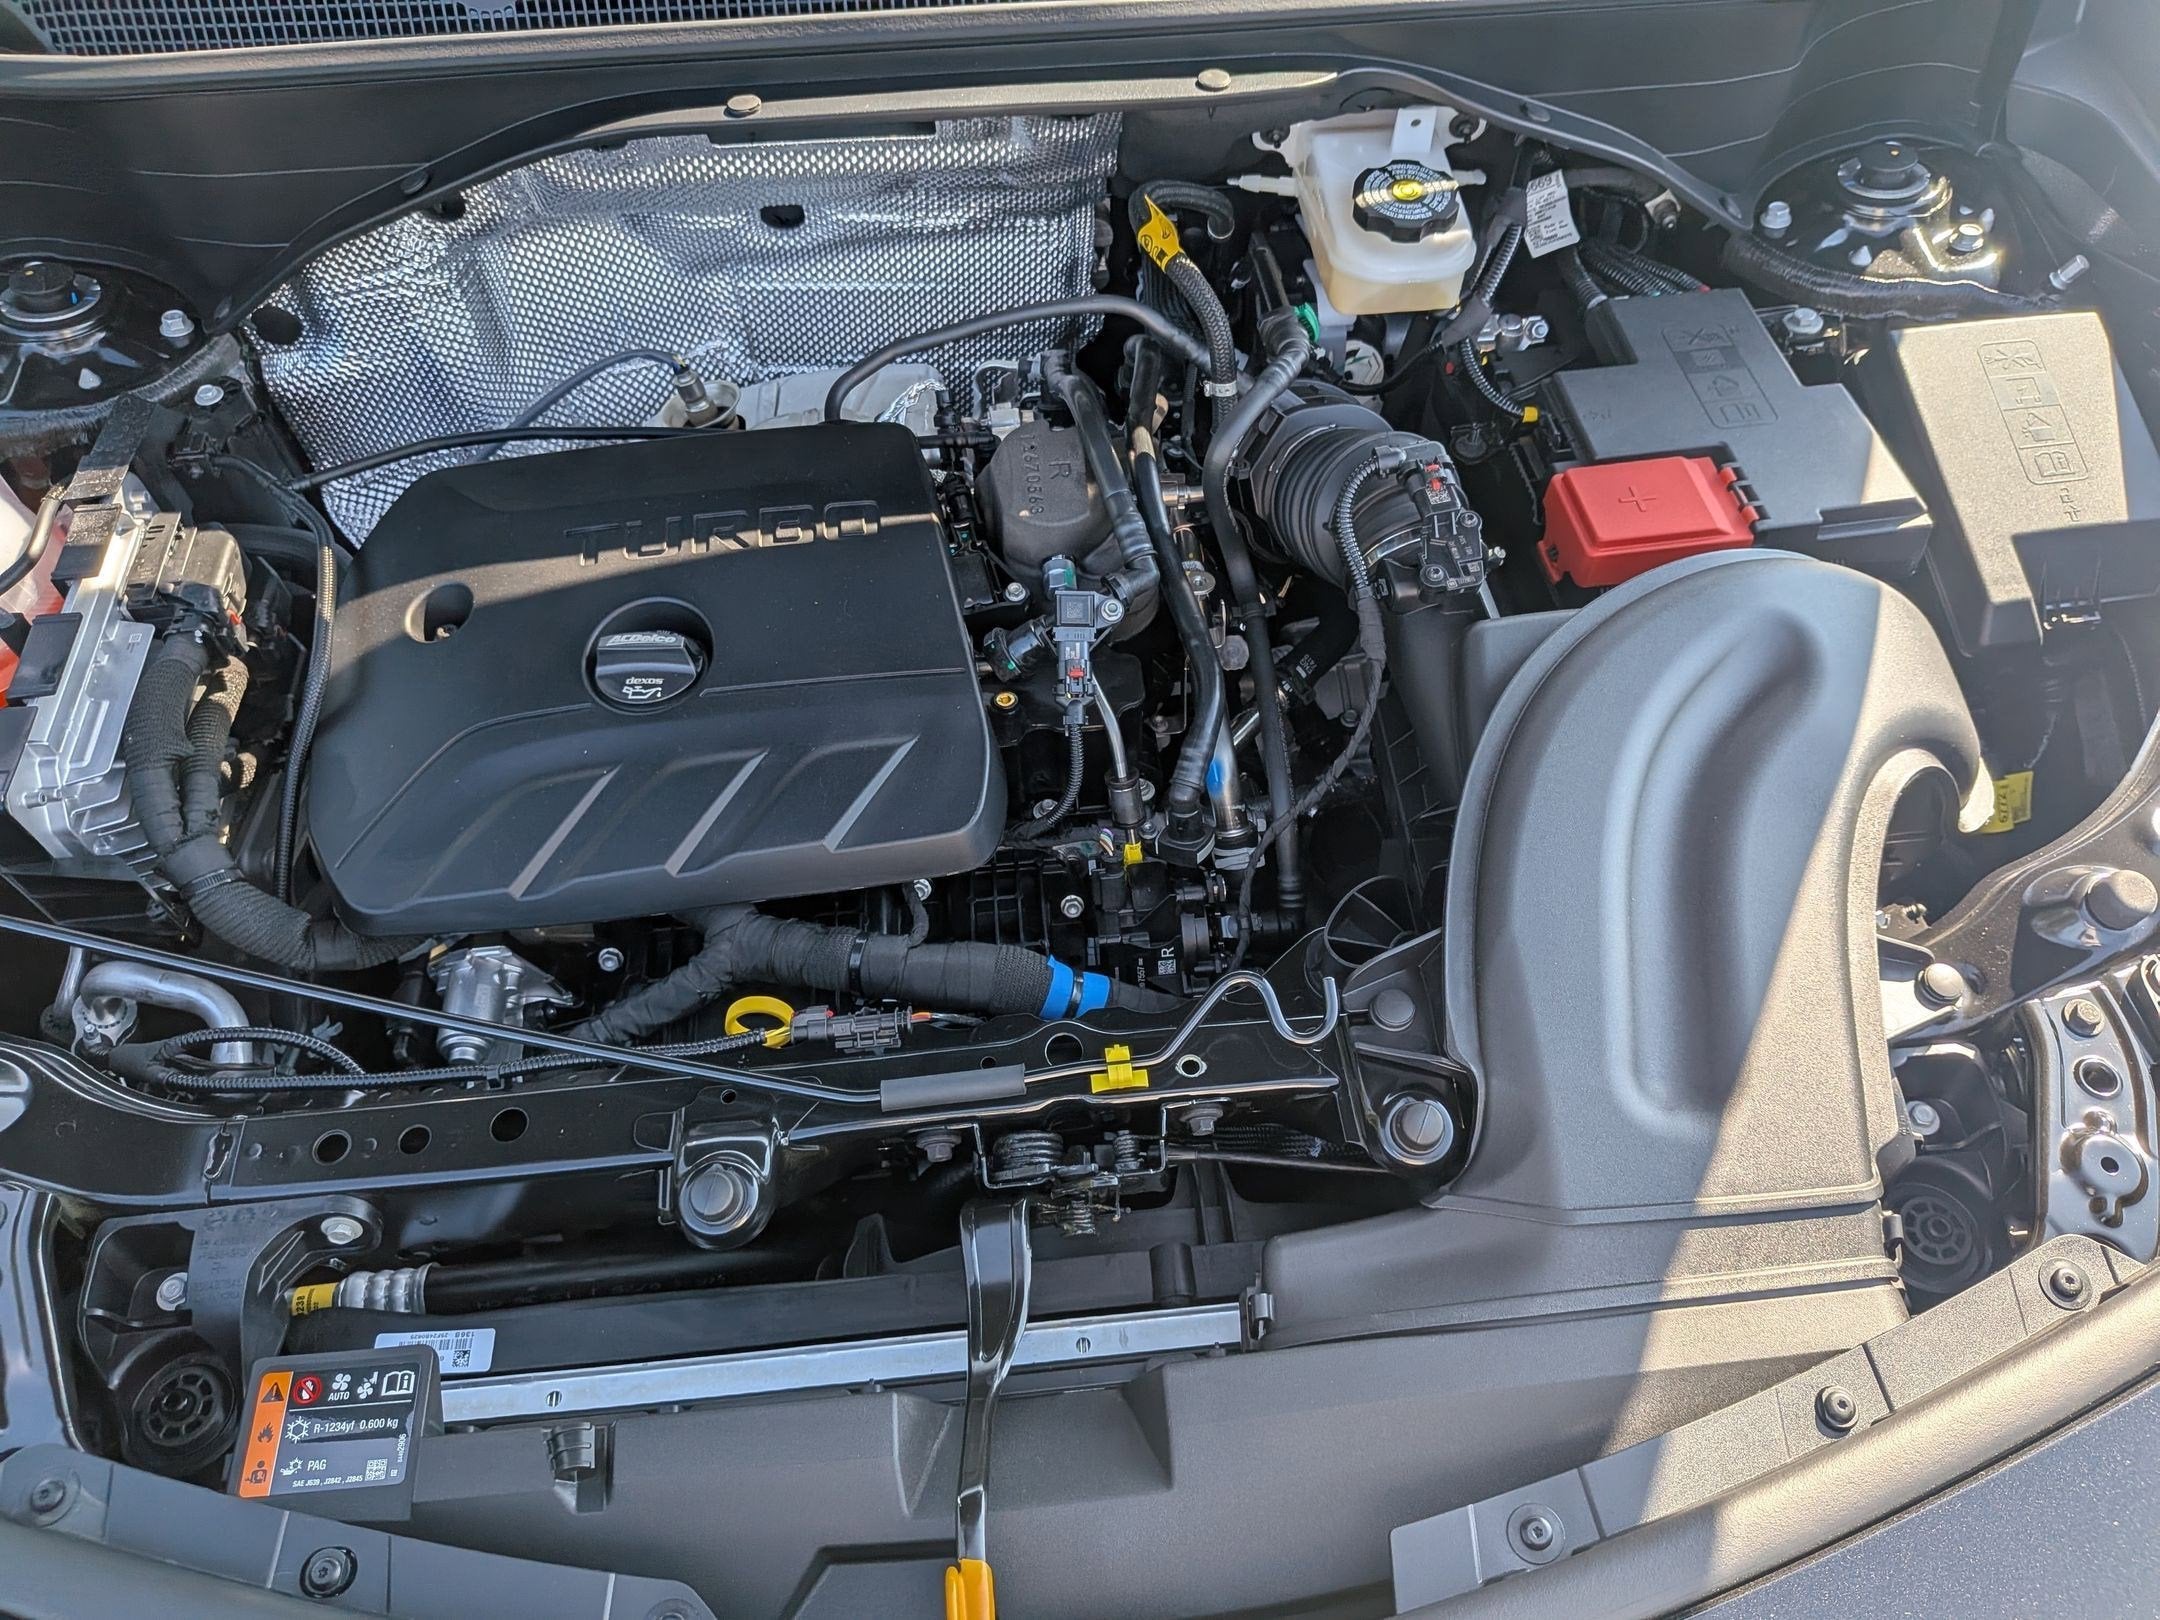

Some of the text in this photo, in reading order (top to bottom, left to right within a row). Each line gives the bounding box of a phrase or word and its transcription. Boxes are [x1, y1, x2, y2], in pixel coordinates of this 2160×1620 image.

[1048, 460, 1072, 480] R
[563, 499, 881, 567] TURBO
[606, 633, 677, 646] ACDelco
[626, 676, 665, 685] dexos
[1161, 947, 1174, 957] R
[328, 1391, 350, 1402] AUTO
[313, 1418, 399, 1434] R-1234yf 0.600 kg
[307, 1459, 327, 1471] PAG
